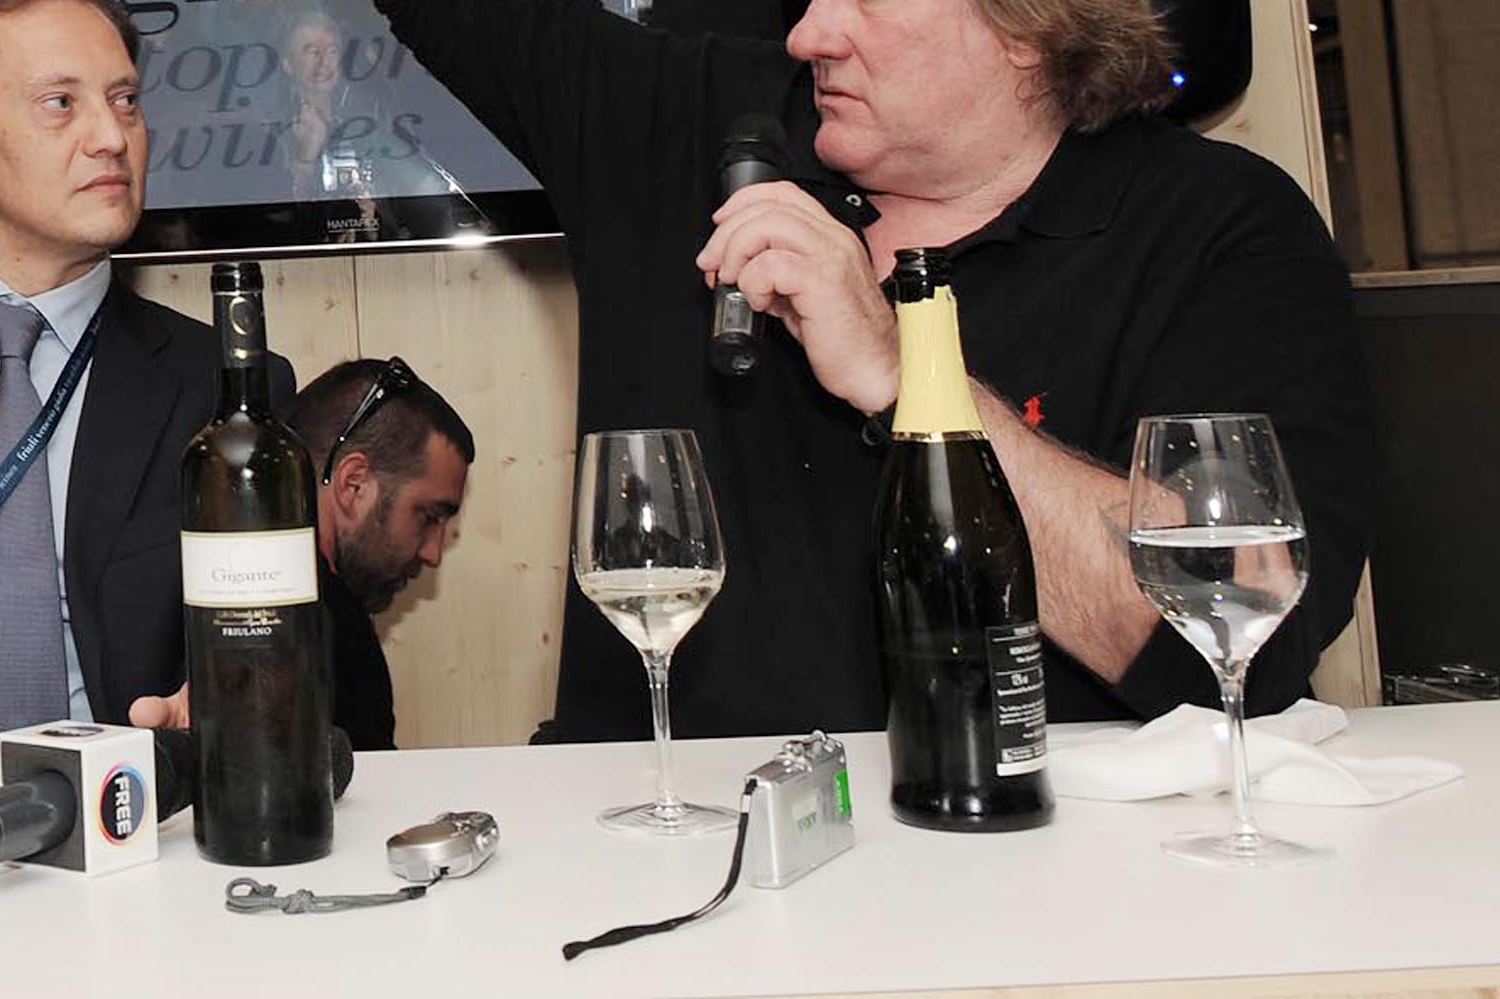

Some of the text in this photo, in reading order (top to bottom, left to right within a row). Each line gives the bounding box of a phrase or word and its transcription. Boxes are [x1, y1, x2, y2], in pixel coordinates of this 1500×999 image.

[17, 436, 39, 462] friuli
[211, 568, 277, 585] Gigante
[221, 626, 273, 637] FRIULANO
[114, 776, 133, 836] FREE
